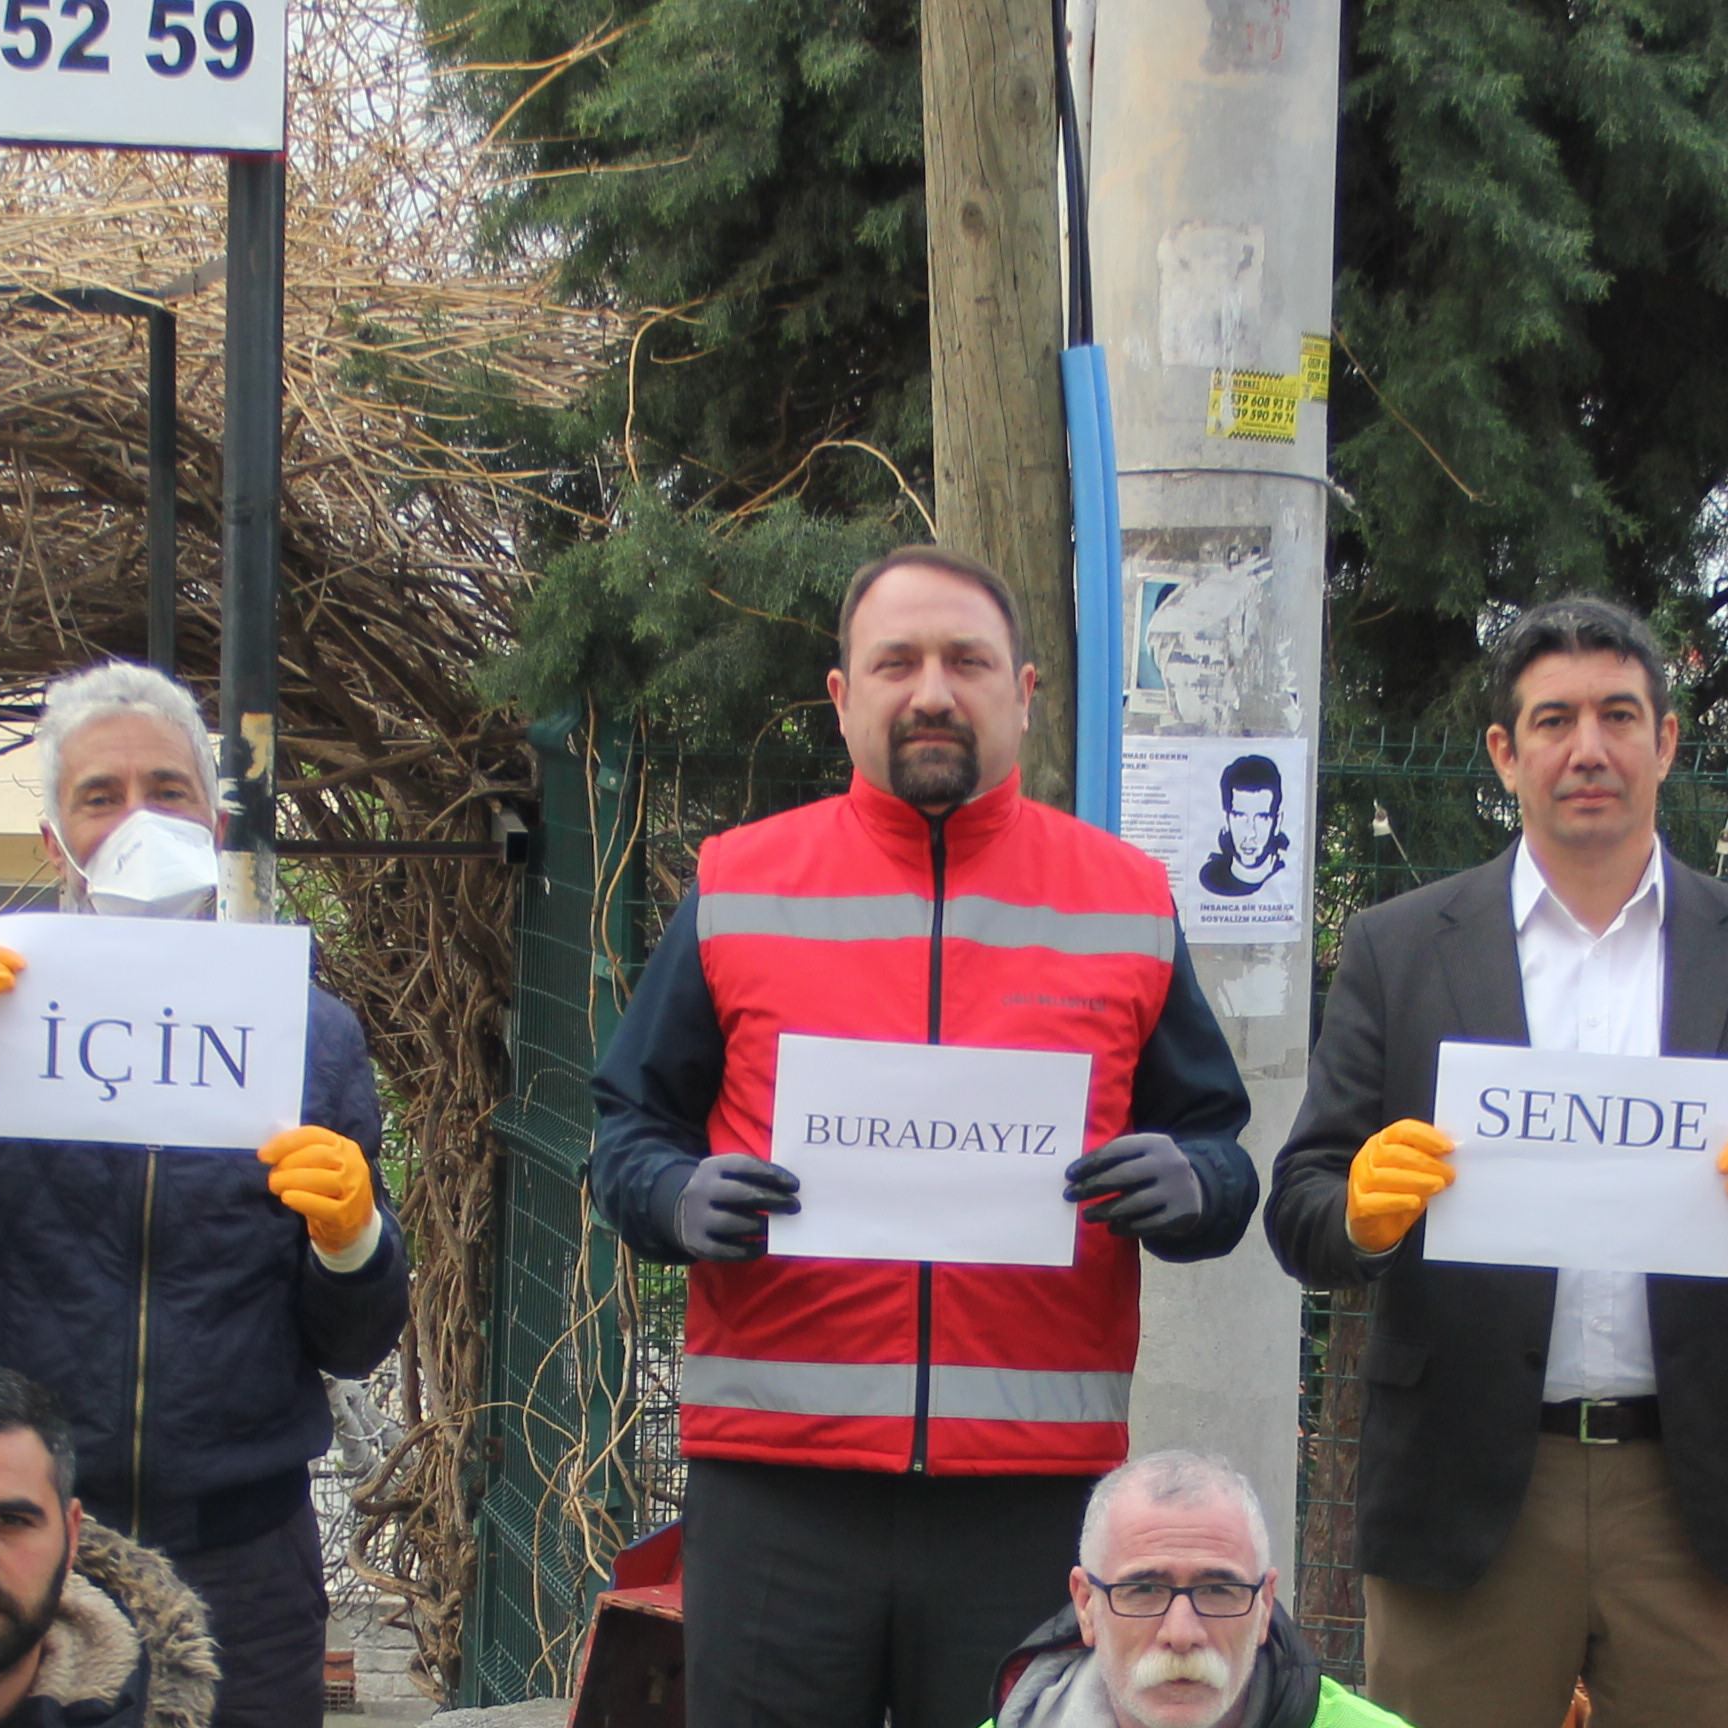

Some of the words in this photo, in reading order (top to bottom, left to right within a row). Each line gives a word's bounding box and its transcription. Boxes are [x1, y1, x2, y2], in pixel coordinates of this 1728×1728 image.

[1, 0, 112, 74] 52
[145, 0, 255, 81] 59
[1200, 902, 1240, 912] İNSANCA
[1242, 902, 1256, 912] BİR
[1200, 914, 1250, 923] SOSYALİZM
[39, 1000, 255, 1103] İÇİN
[803, 1113, 1057, 1156] BURADAYIZ
[1476, 1087, 1708, 1152] SENDE
